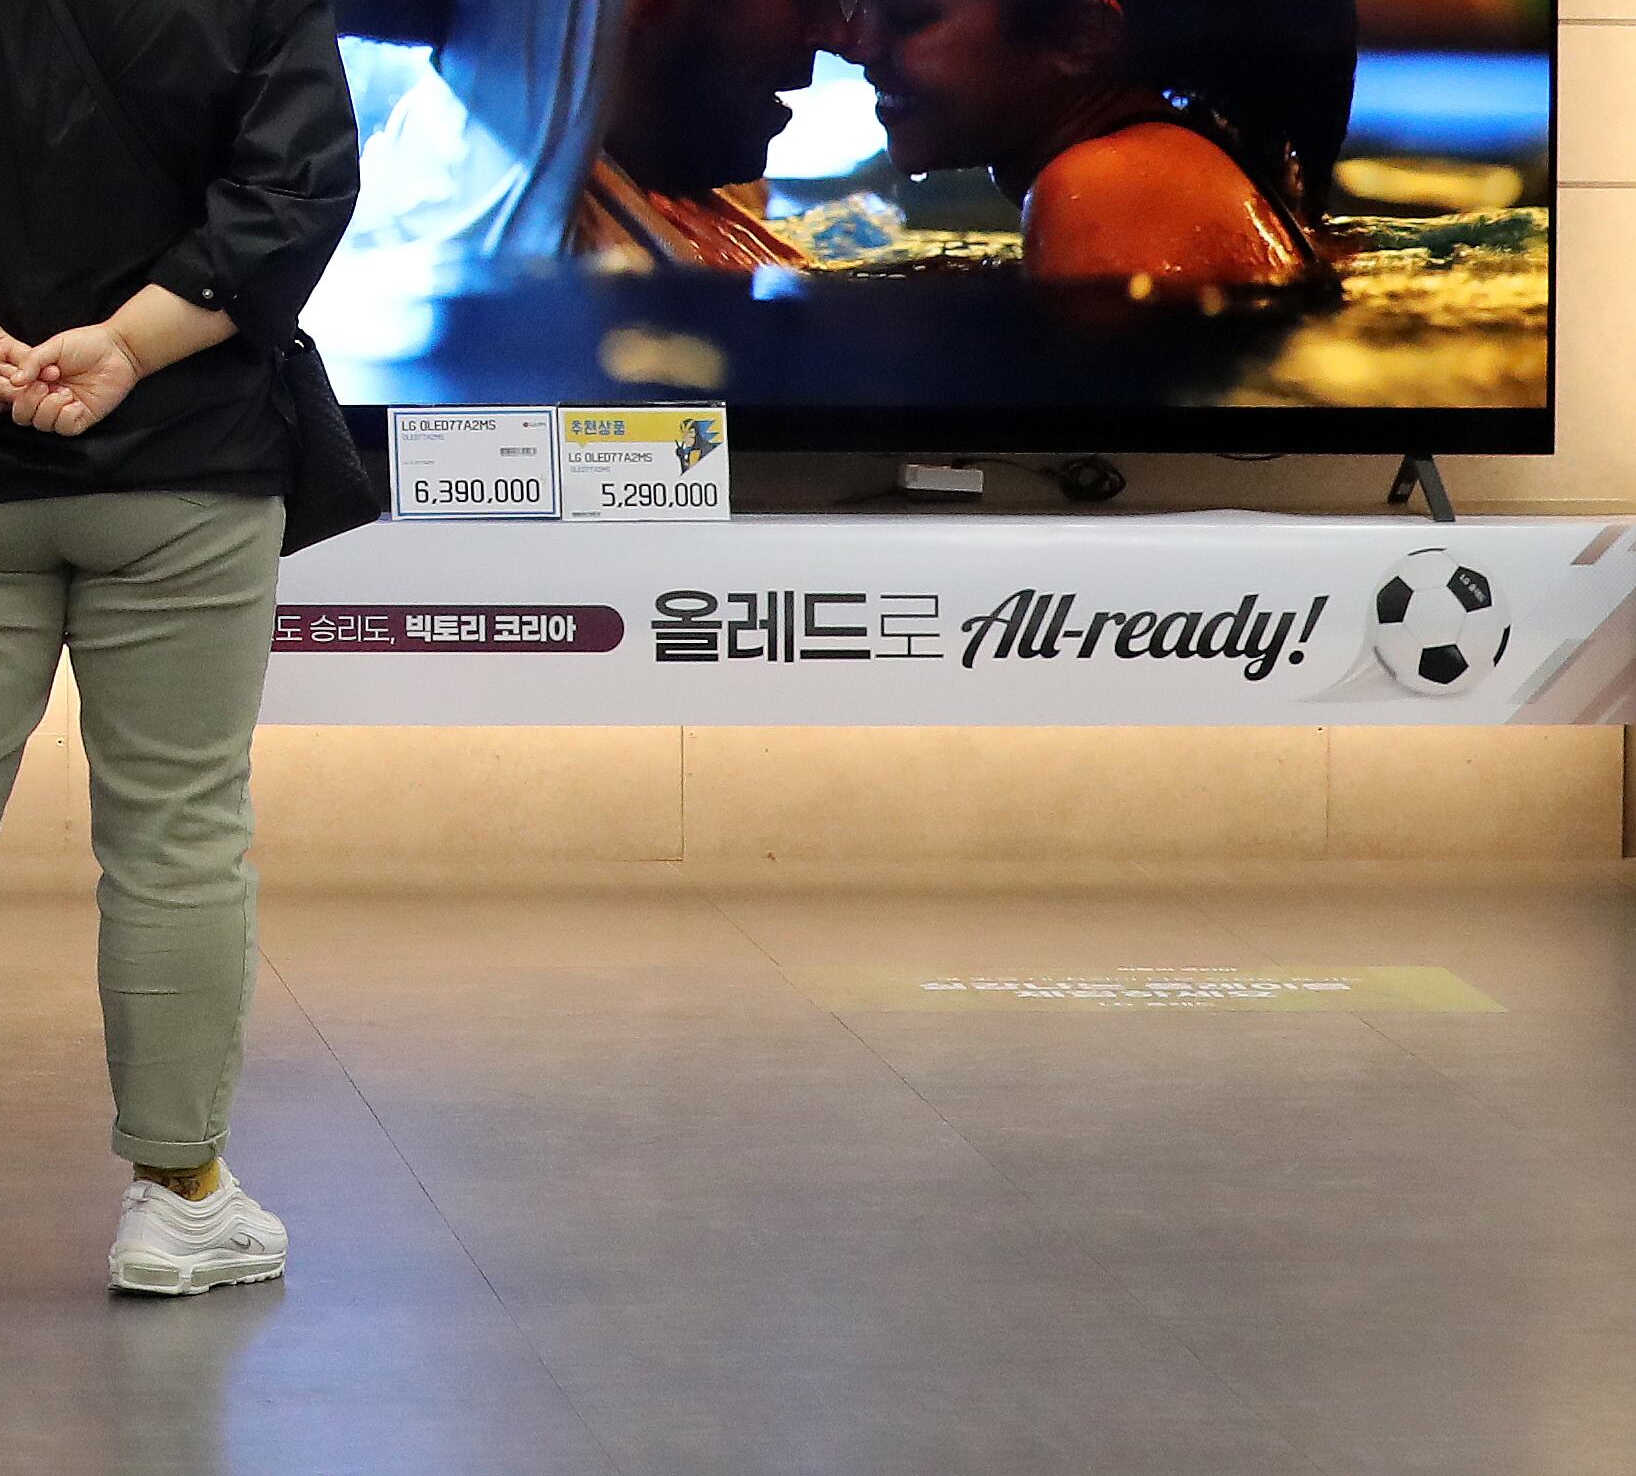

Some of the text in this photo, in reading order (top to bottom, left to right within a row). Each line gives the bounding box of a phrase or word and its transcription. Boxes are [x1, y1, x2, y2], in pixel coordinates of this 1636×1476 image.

[402, 420, 496, 431] LG OLED77A2MS
[569, 453, 652, 462] LG OLED77A2MS
[415, 479, 541, 504] 6,390,000
[602, 483, 717, 507] 5,290,000
[310, 615, 395, 646] 승리도,
[405, 615, 484, 643] 빅토리
[494, 615, 576, 643] 코리아
[651, 588, 1330, 681] 올레드로 All-ready!
